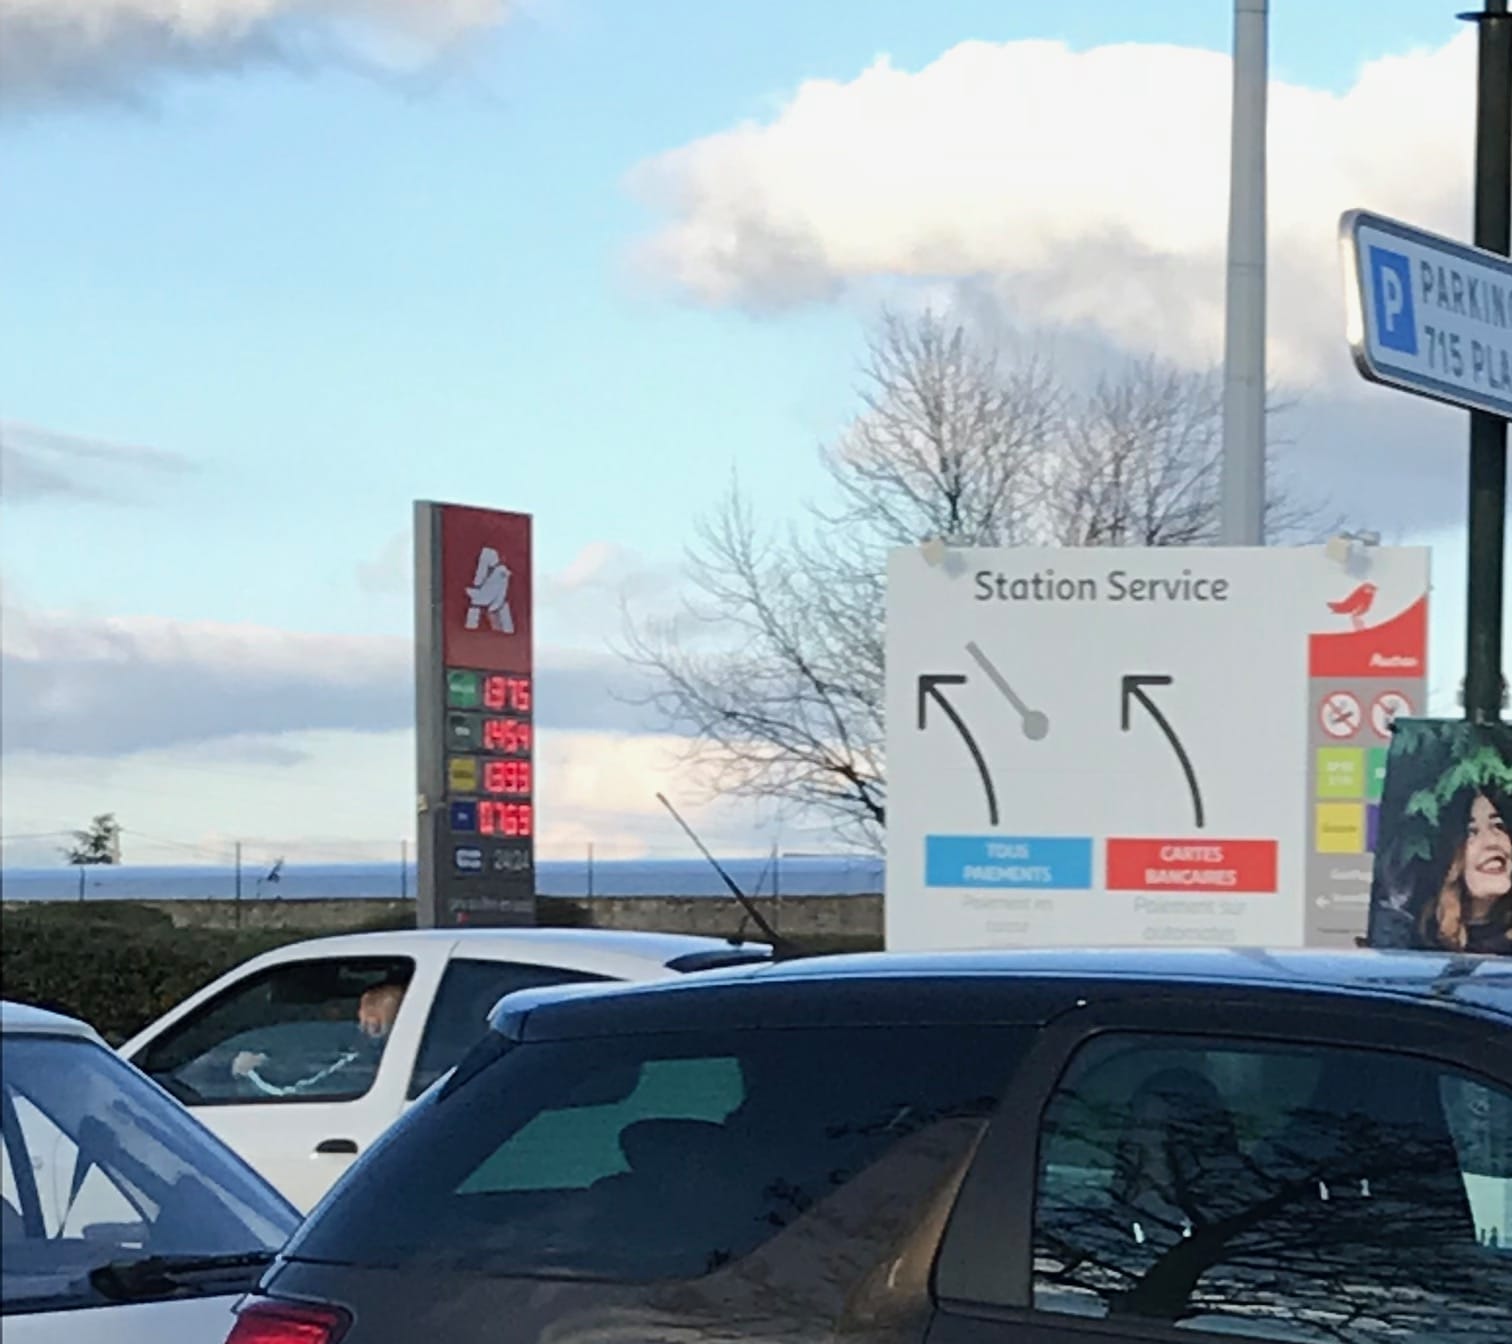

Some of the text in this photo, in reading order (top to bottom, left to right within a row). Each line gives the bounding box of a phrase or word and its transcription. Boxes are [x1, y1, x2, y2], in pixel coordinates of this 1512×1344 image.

[1380, 264, 1403, 332] P
[1424, 325, 1465, 378] 715
[974, 568, 1230, 601] Station Service
[986, 842, 1030, 860] TOUS
[1159, 846, 1224, 863] CARTES
[1144, 868, 1237, 887] BANCAIRES
